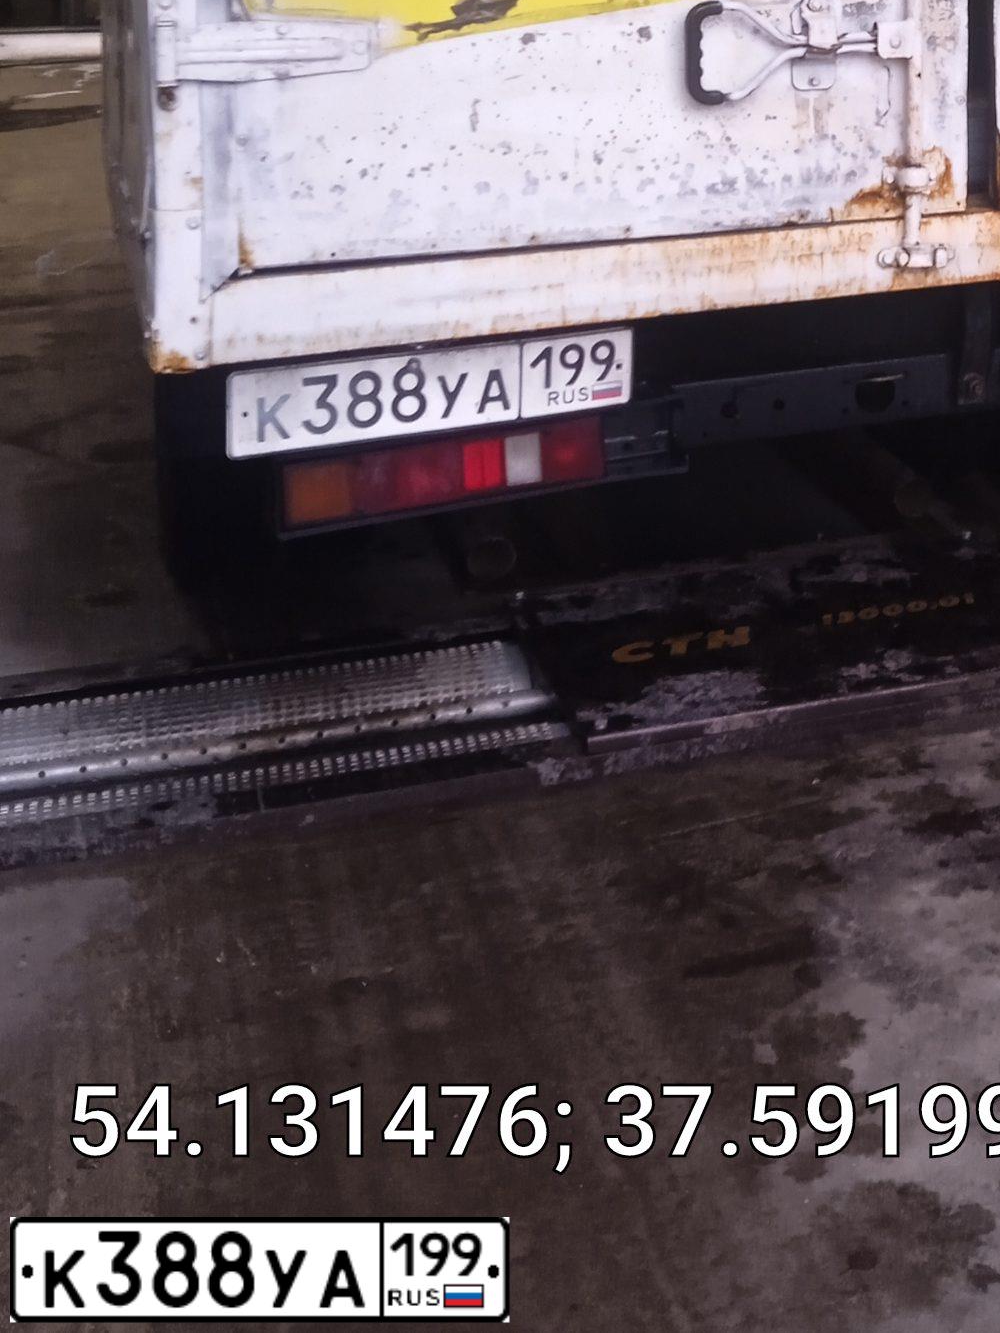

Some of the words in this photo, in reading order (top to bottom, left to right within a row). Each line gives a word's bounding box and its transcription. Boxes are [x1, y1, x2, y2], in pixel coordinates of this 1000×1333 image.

[529, 338, 617, 389] 199
[255, 365, 512, 443] К388УА
[547, 386, 589, 407] RUS
